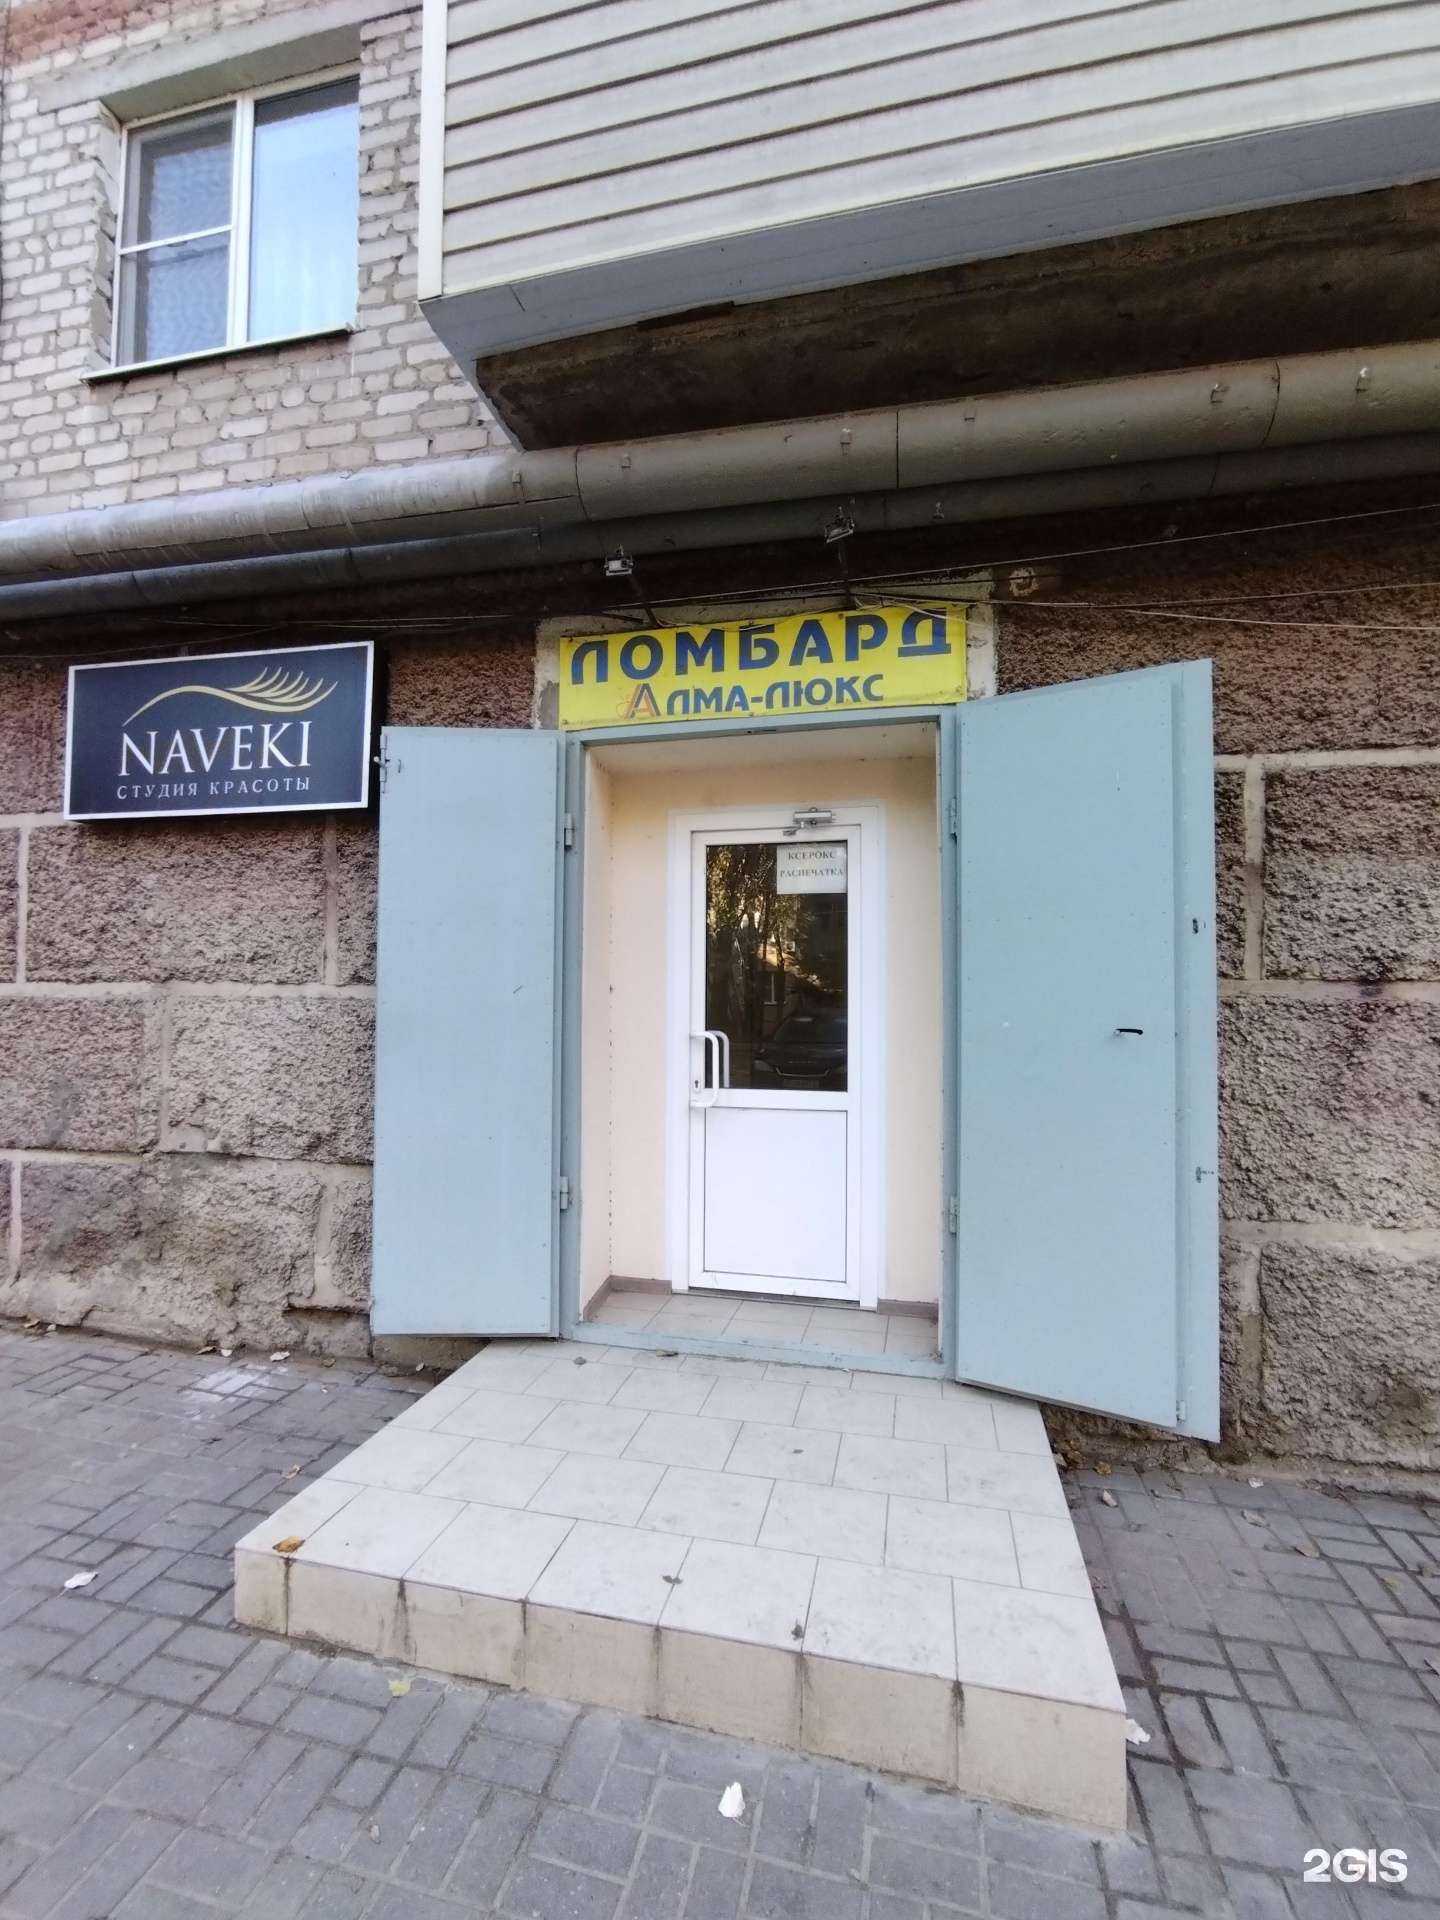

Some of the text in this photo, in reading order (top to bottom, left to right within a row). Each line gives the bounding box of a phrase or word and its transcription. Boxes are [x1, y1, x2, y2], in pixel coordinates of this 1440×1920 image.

[571, 608, 952, 685] ЛОМБАРД
[118, 720, 313, 776] NAVEKI
[116, 776, 310, 800] СТУДИЯ КРАСОТЫ
